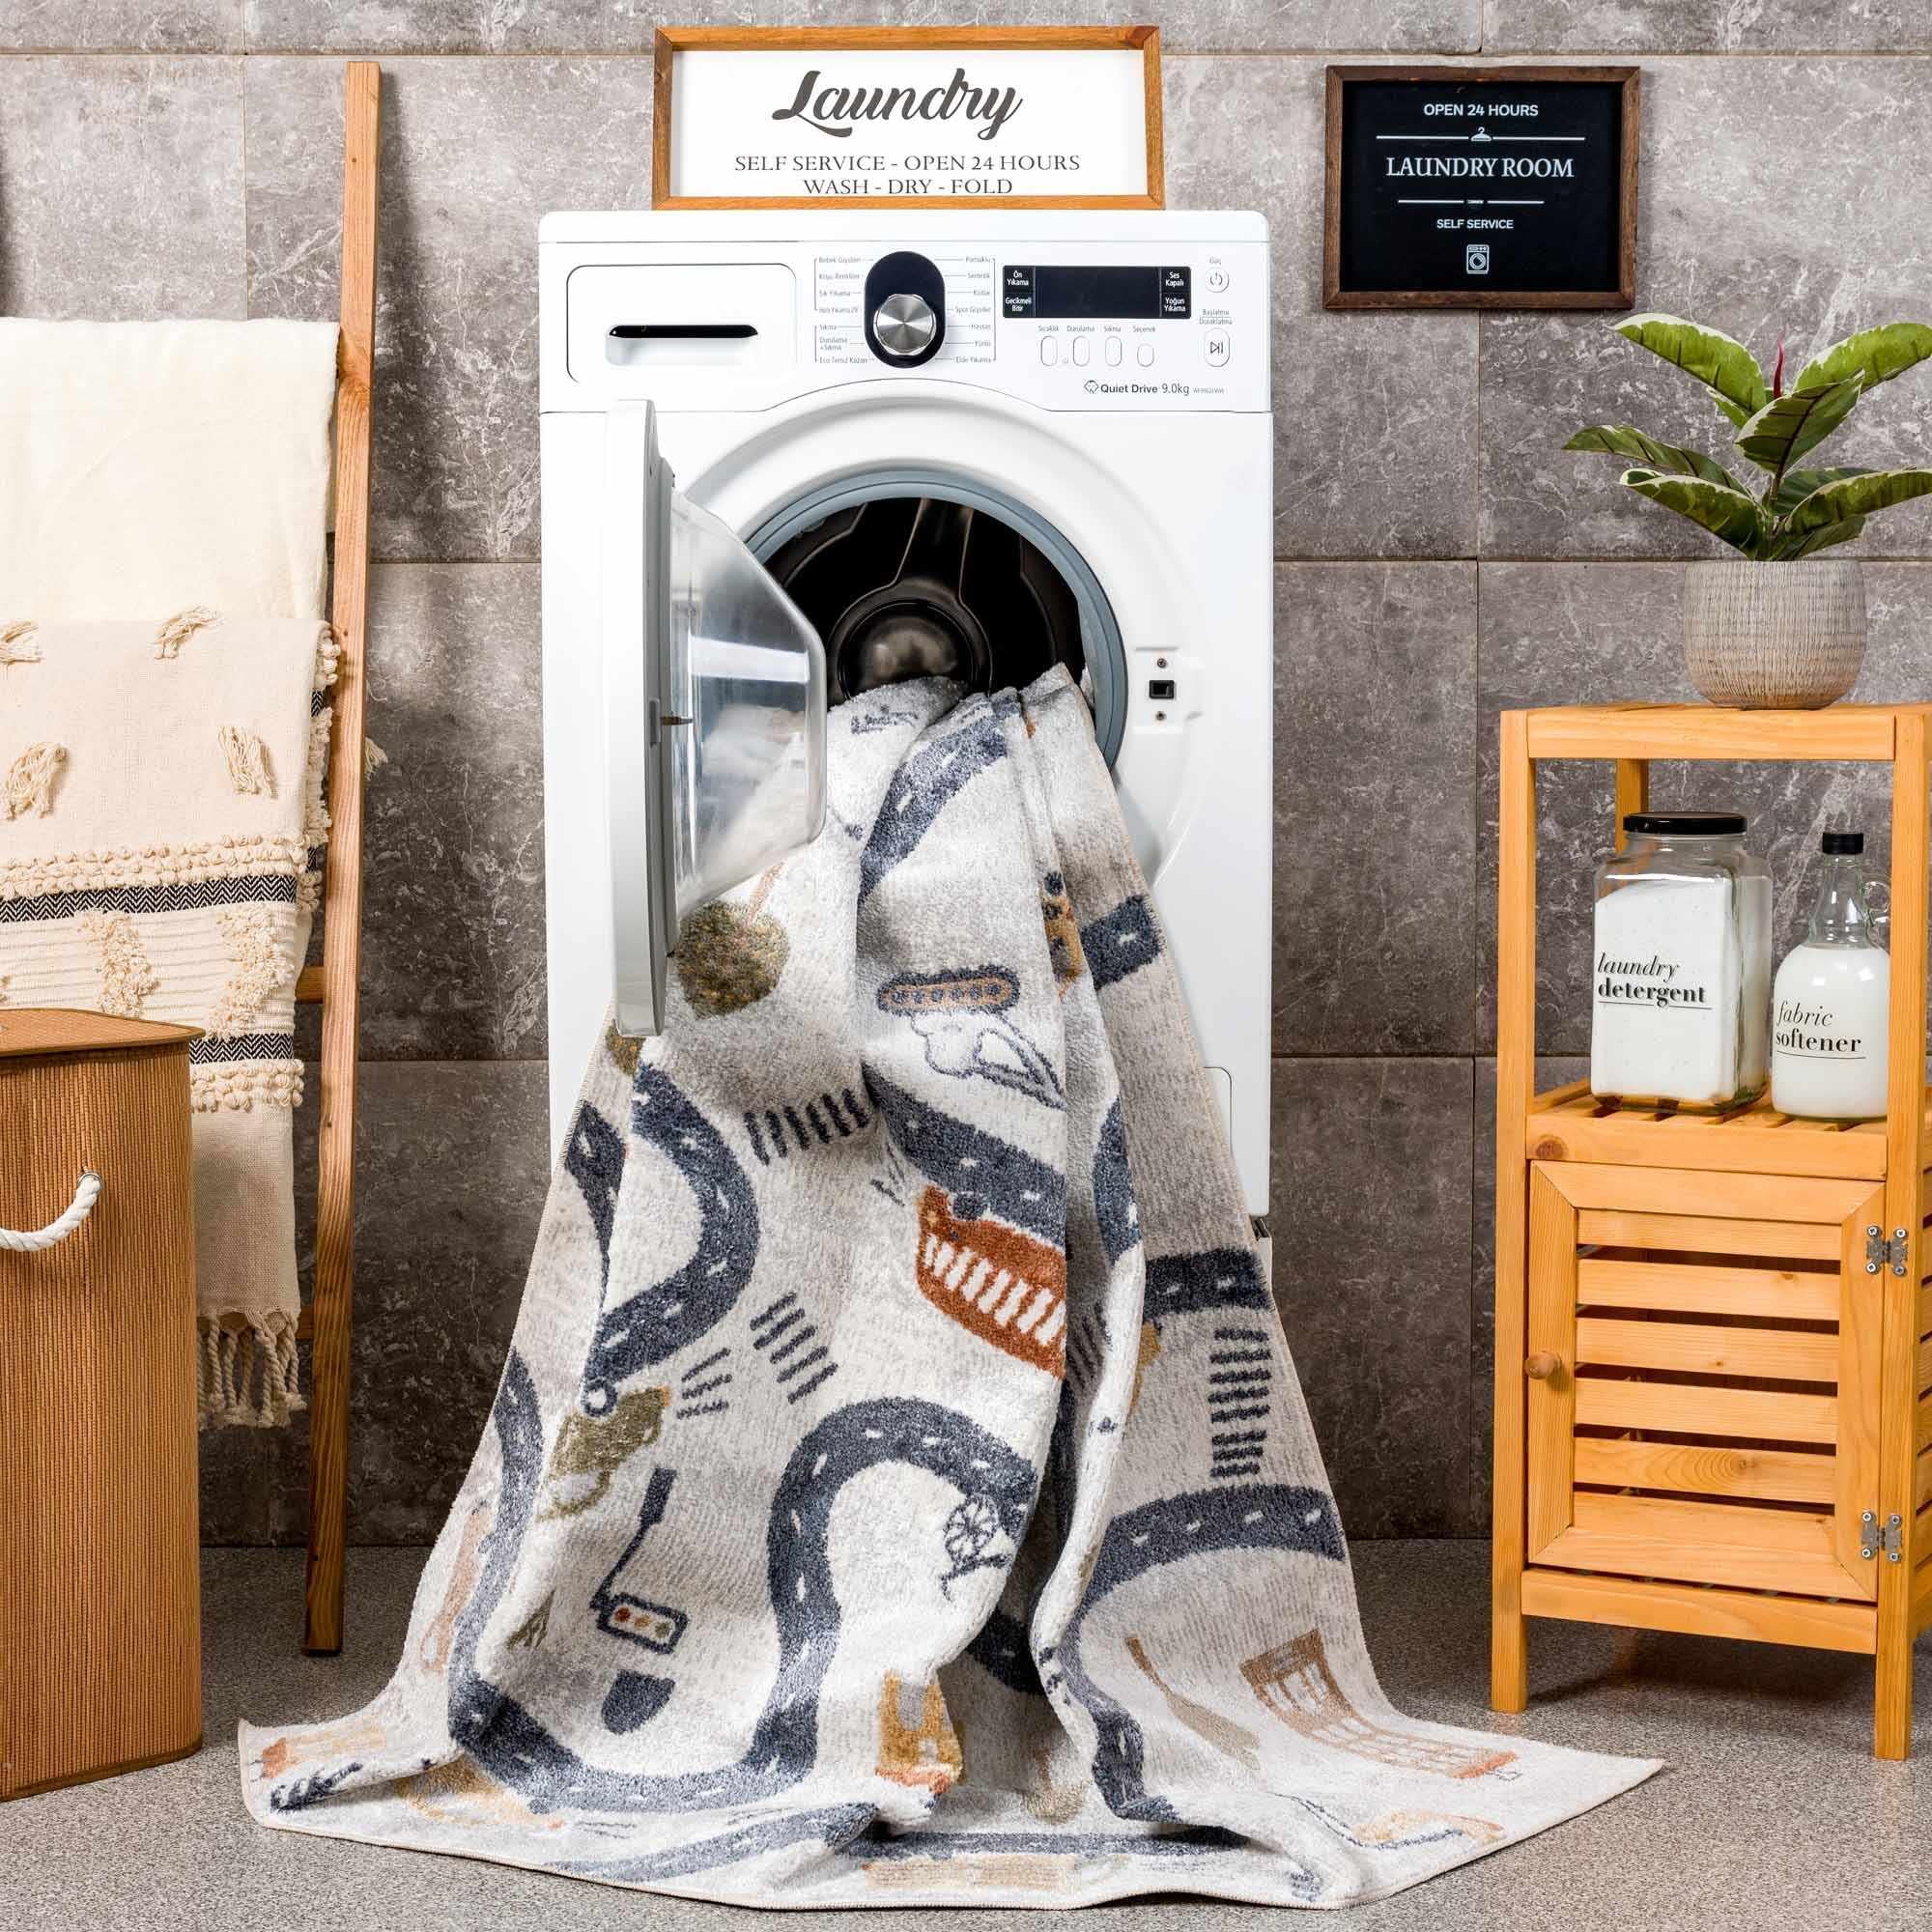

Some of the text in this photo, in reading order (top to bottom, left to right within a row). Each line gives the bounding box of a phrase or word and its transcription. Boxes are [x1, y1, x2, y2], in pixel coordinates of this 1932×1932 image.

[772, 68, 1023, 140] Laundry
[1423, 103, 1539, 117] OPEN 24 HOURS
[734, 155, 787, 171] SELF
[792, 155, 886, 171] SERVICE
[903, 155, 965, 171] OPEN
[971, 155, 995, 171] 24
[1000, 155, 1080, 171] HOURS
[1385, 156, 1576, 178] LAUNDRY ROOM
[803, 178, 868, 194] WASH
[888, 178, 932, 194] DRY
[950, 178, 1013, 194] FOLD
[1436, 218, 1514, 230] SELF SERVICE
[1013, 270, 1023, 279] Ön
[1100, 384, 1129, 394] Quiet
[1131, 384, 1158, 394] Drive
[1161, 383, 1190, 397] 9.0kg
[1597, 952, 1680, 981] laundry
[1598, 976, 1707, 1007] detergent
[1776, 1000, 1833, 1027] fabric
[1775, 1027, 1862, 1053] softener
